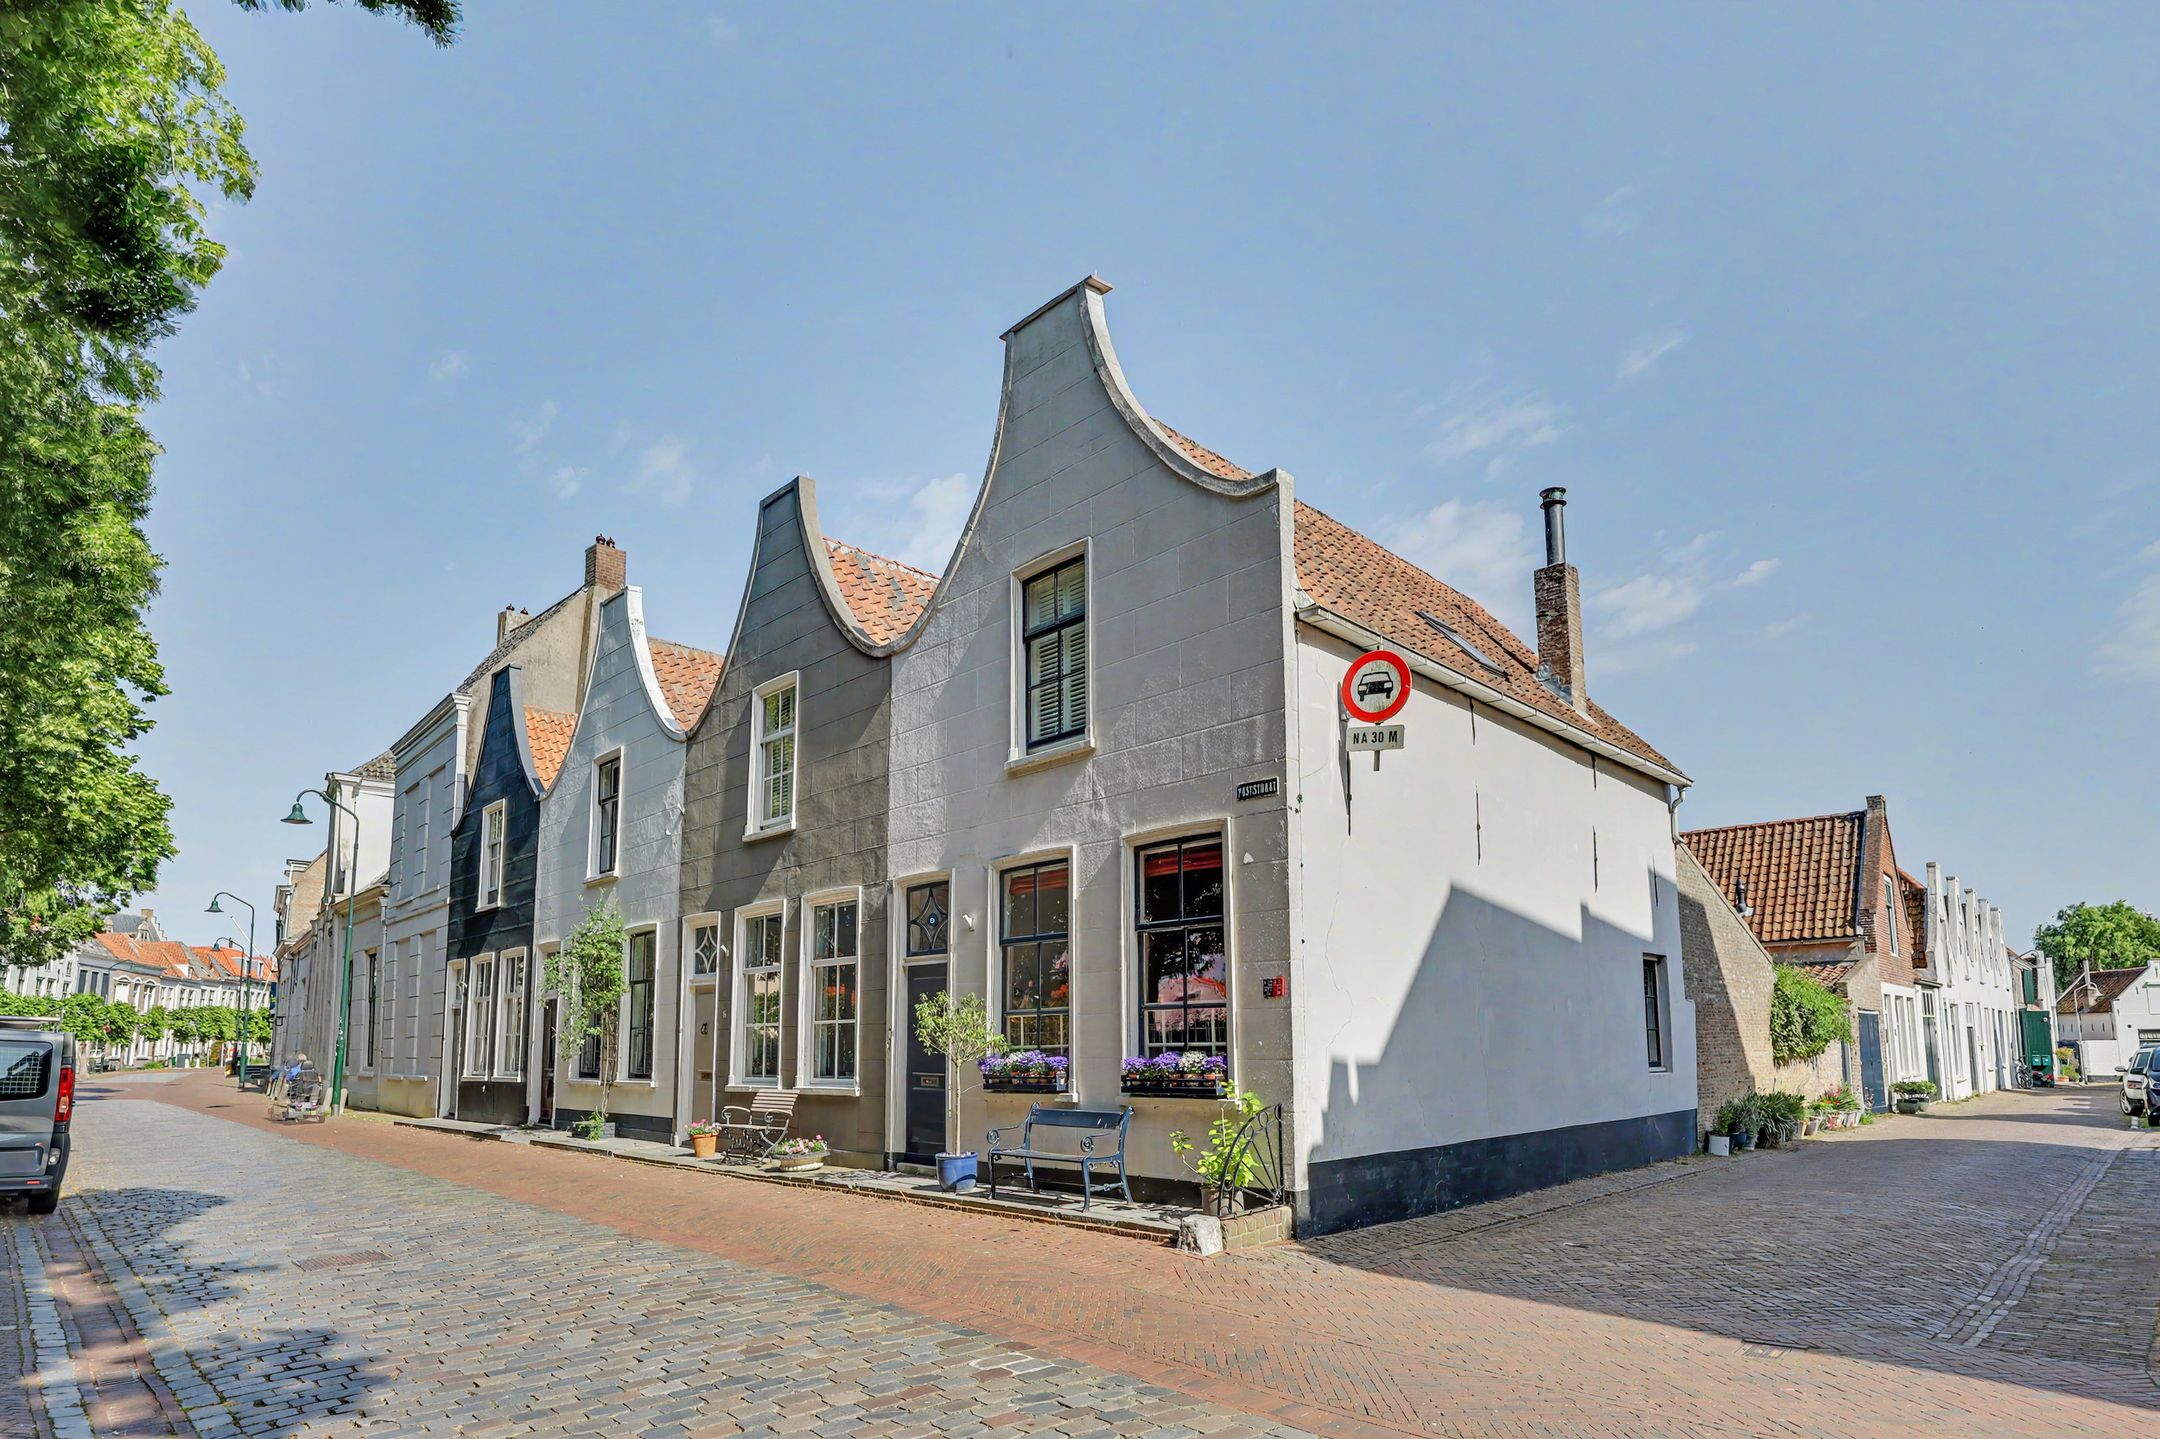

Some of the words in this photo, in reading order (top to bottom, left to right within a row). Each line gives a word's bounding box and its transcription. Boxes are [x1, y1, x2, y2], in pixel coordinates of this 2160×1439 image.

[1353, 732, 1368, 744] NA
[1371, 731, 1384, 743] 30
[1389, 730, 1398, 743] M
